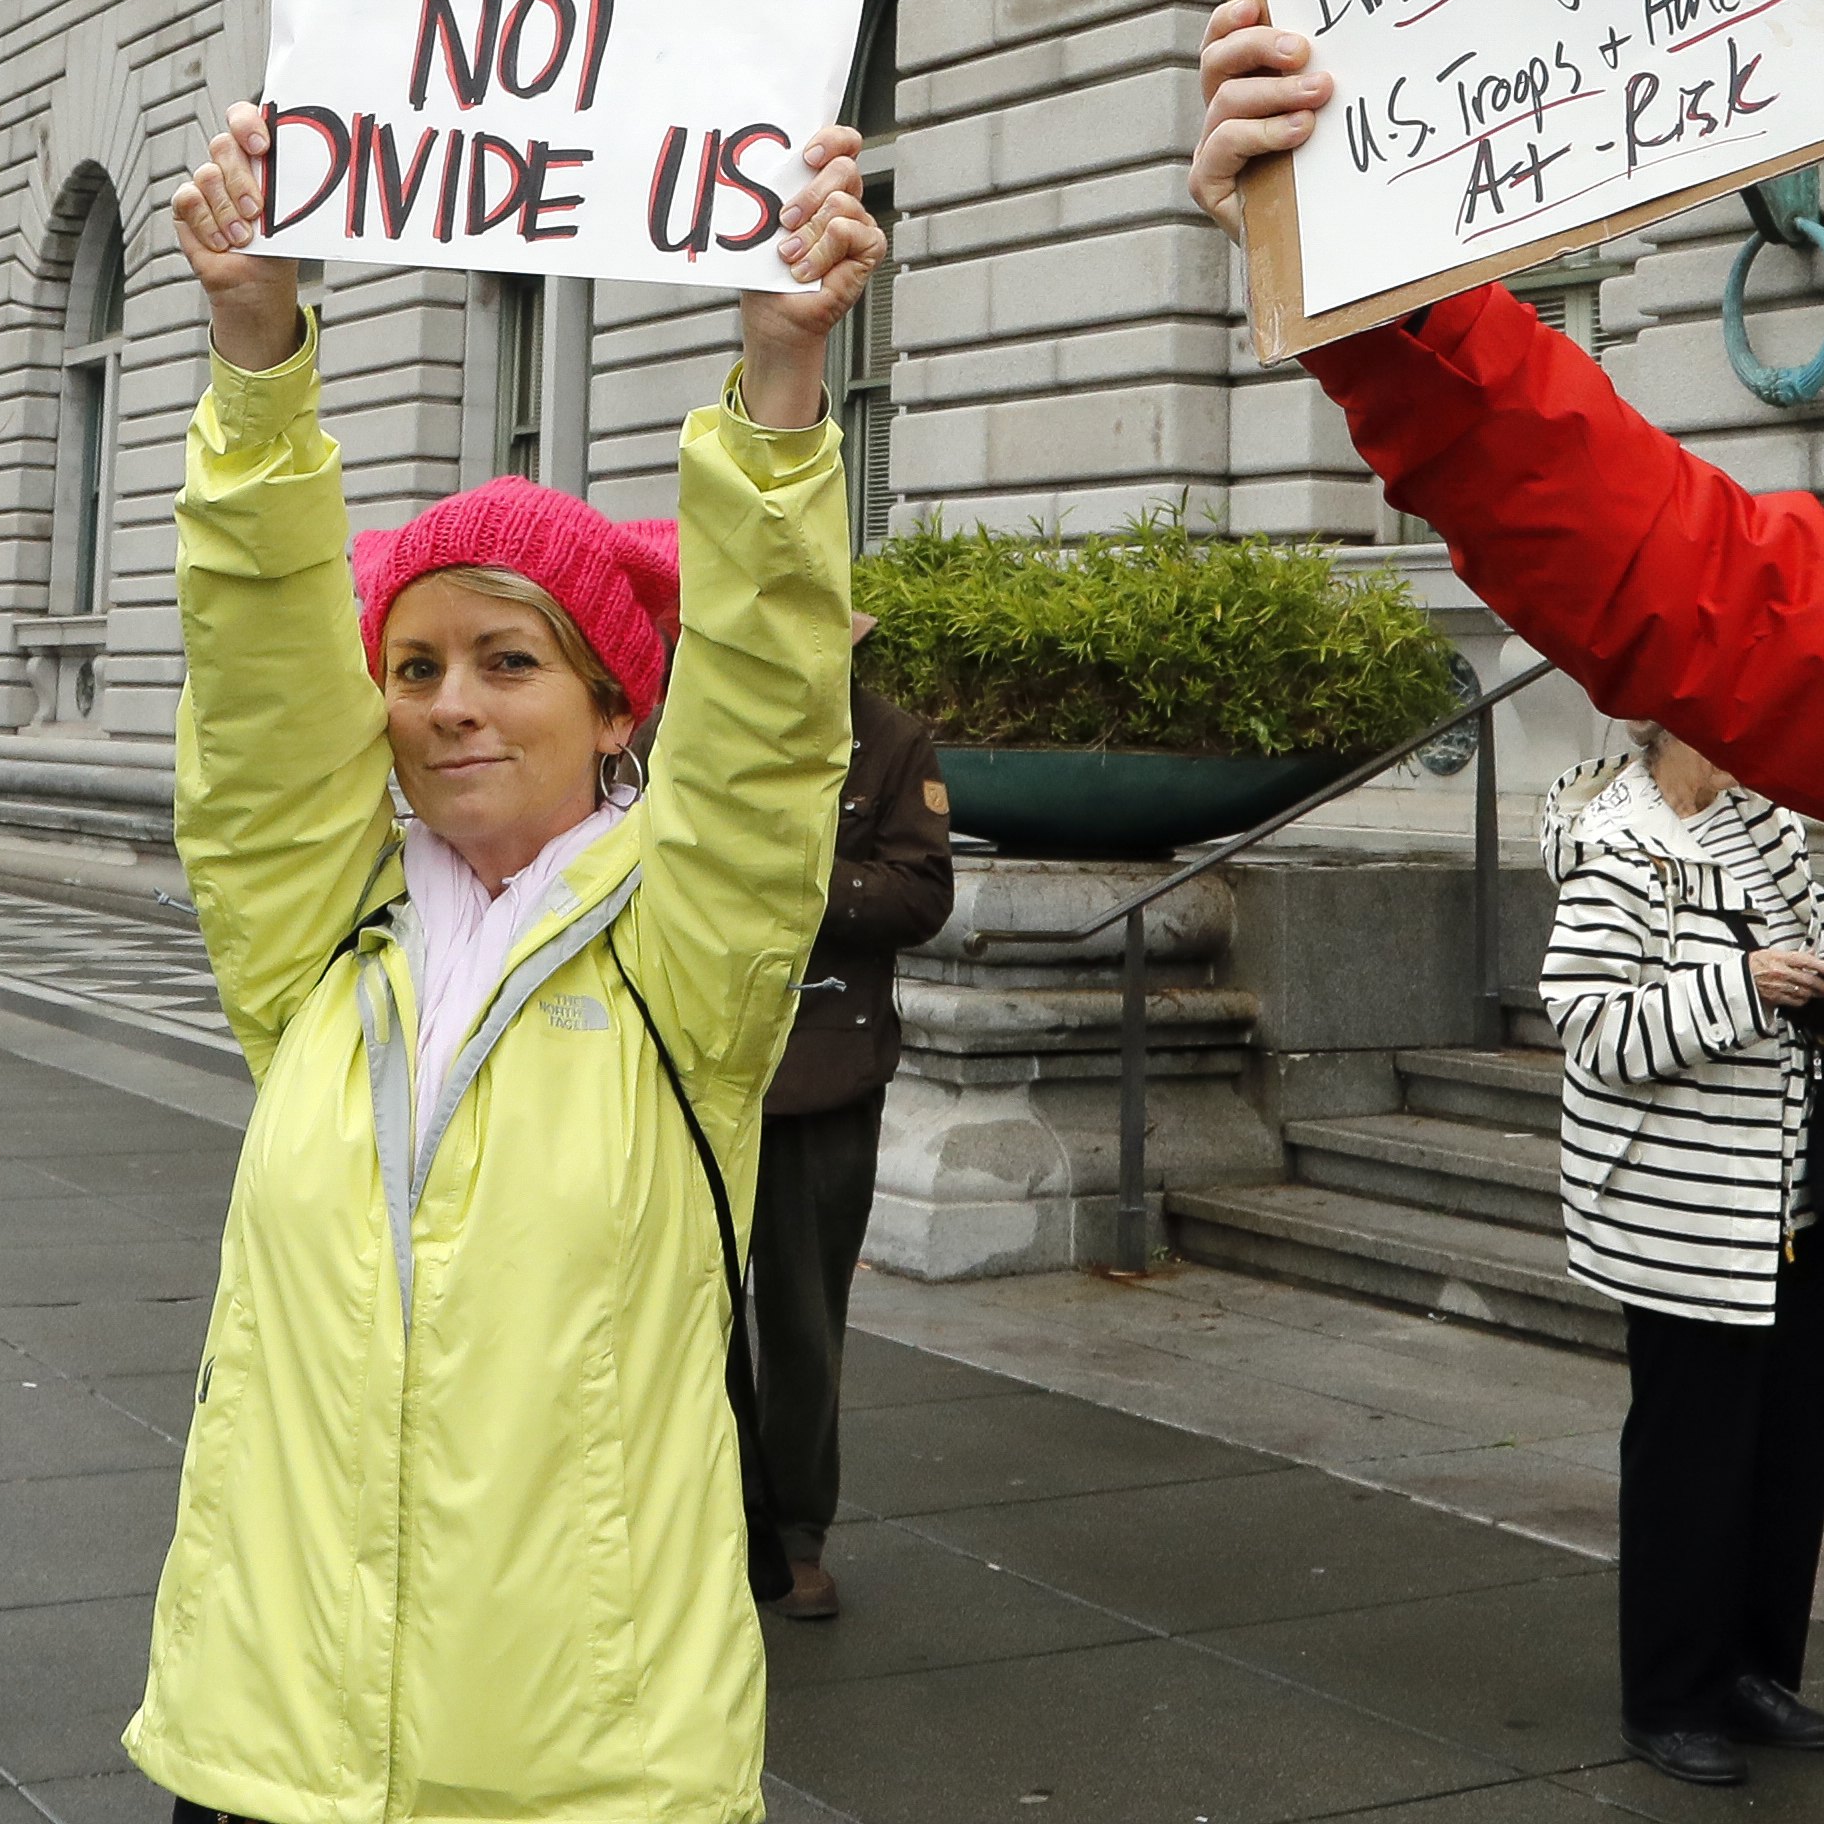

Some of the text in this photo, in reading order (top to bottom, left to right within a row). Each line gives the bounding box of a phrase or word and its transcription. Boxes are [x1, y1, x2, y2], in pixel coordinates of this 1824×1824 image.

[1345, 77, 1436, 172] U.S.
[1437, 40, 1583, 136] Troops
[260, 101, 792, 263] DIVIDE US
